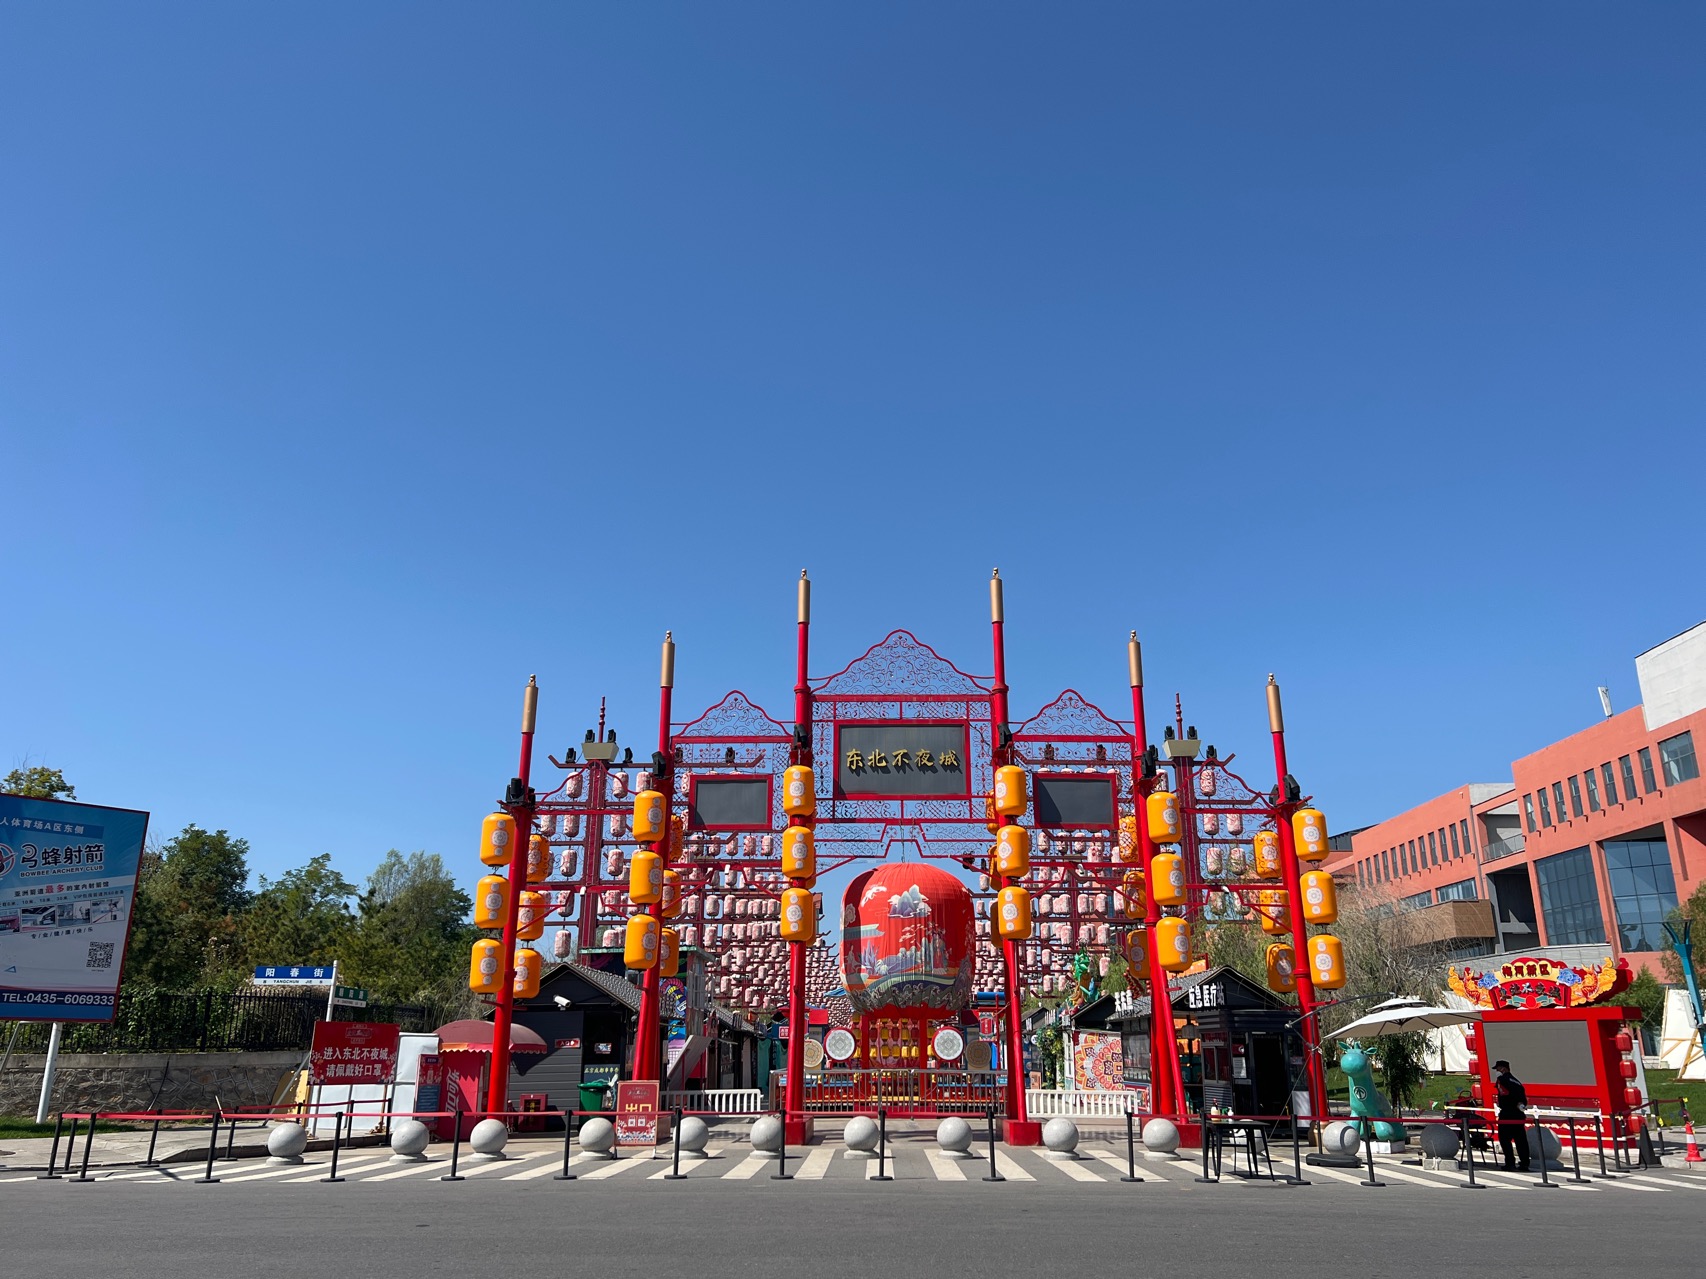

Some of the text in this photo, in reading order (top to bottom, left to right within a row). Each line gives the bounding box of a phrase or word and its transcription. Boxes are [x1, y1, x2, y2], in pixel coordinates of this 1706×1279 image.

[845, 748, 958, 770] 东北不夜城
[20, 870, 50, 878] BOWBEE
[52, 867, 84, 875] ARCHERY
[265, 968, 324, 978] 阳春街
[1188, 982, 1225, 1009] 应急医疗站
[323, 1046, 389, 1061] 进入东北不夜城
[326, 1063, 382, 1078] 请佩戴好口罩
